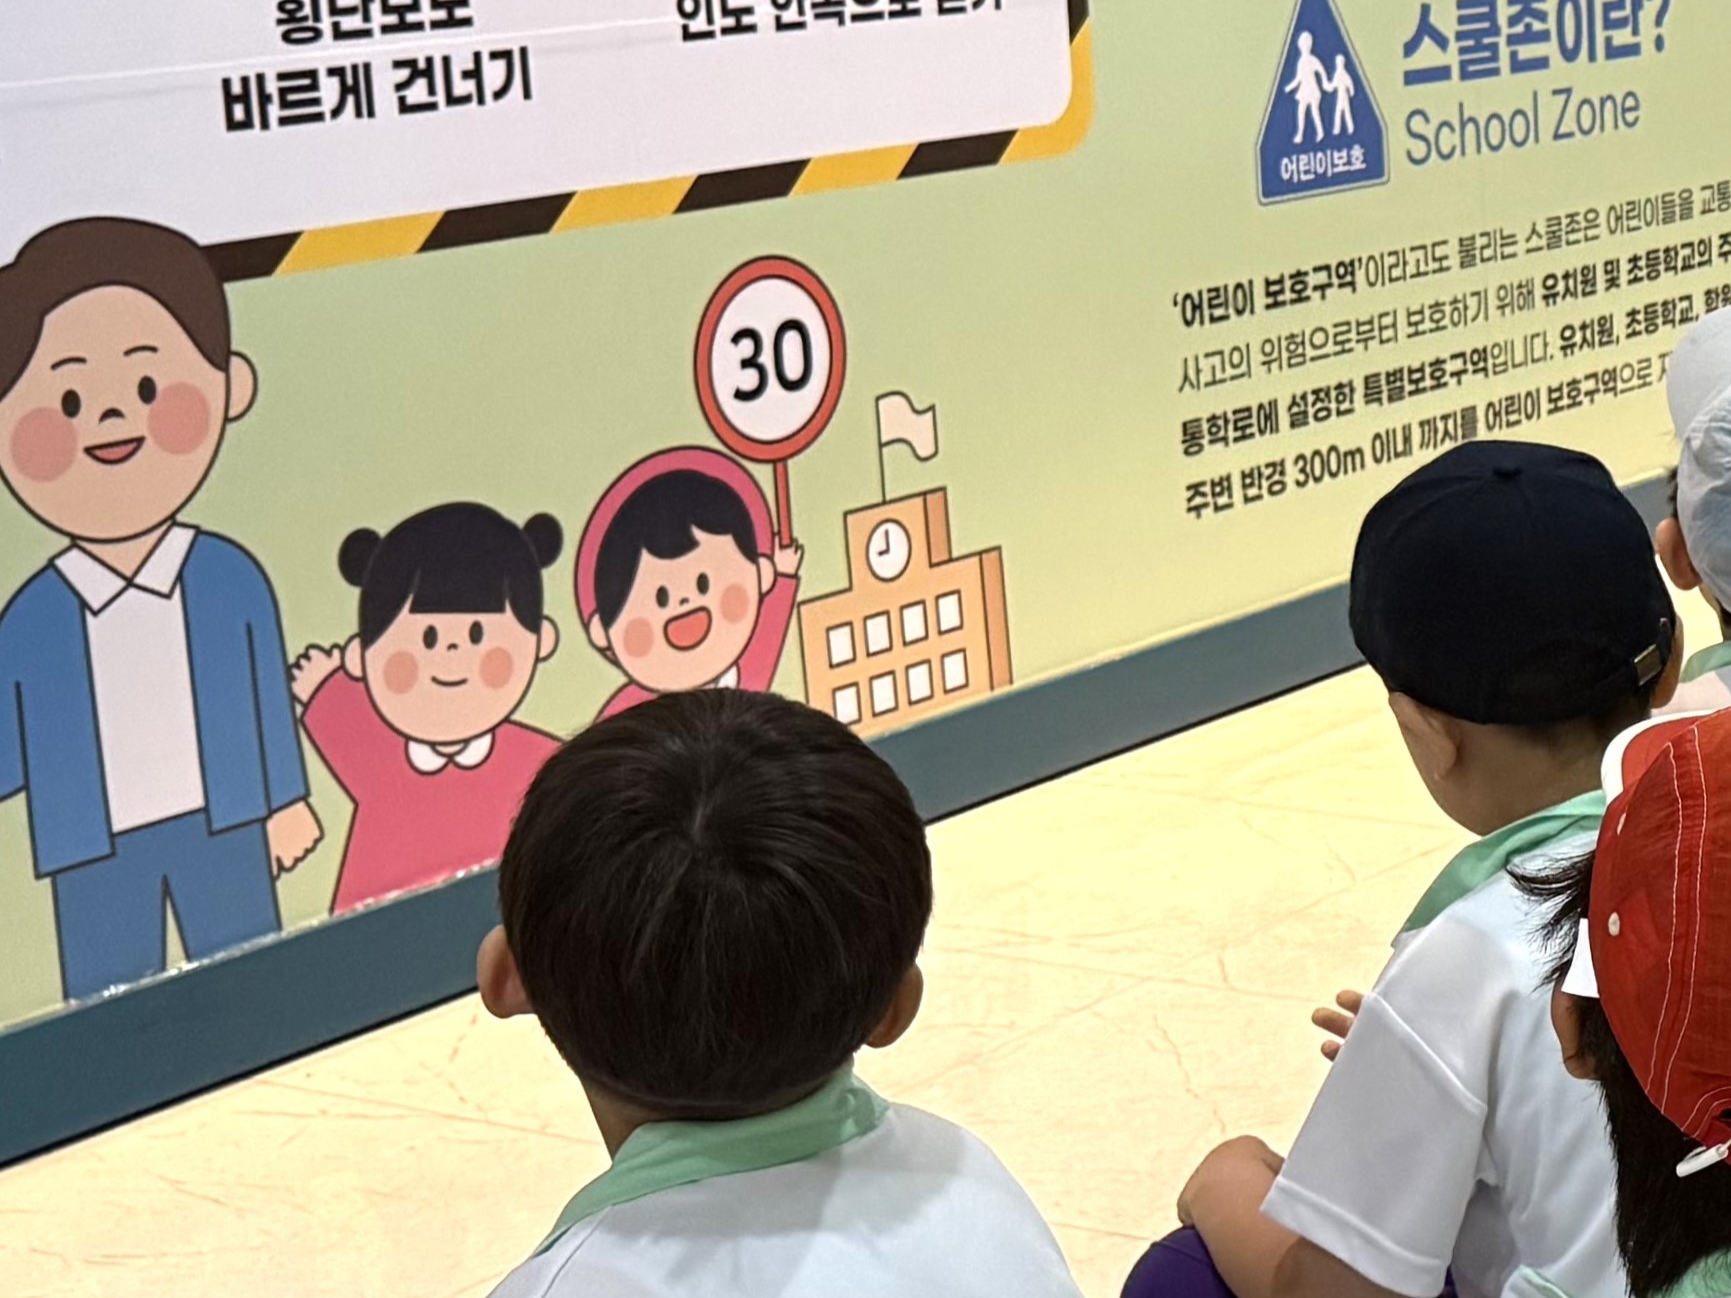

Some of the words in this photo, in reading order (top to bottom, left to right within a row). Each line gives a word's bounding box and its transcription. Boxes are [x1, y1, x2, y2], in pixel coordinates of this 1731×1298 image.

[221, 62, 374, 134] 바르게
[393, 46, 534, 113] 건너기
[1405, 90, 1540, 167] School
[1551, 86, 1641, 142] Zone
[1281, 143, 1367, 183] 어린이보호
[1457, 227, 1518, 270] 불리는
[1525, 207, 1600, 255] 스쿨존은
[1606, 188, 1694, 235] 어린이들을
[1699, 179, 1731, 215] 교통
[1178, 342, 1252, 393] 사고의
[1259, 309, 1399, 375] 위험으로부터
[1405, 287, 1490, 339] 보호하기
[1495, 277, 1536, 318] 위해
[1542, 262, 1598, 308] 유치원
[1603, 257, 1621, 292] 및
[1626, 236, 1713, 286] 초등학교의
[730, 318, 813, 403] 30
[1180, 398, 1280, 457] 통학로에
[1287, 379, 1356, 431] 설정한
[1363, 330, 1554, 408] 특별보호구역입니다.
[1559, 312, 1620, 358] 유치원,
[1625, 293, 1700, 340] 초등학교,
[1185, 473, 1234, 520] 주변
[1240, 457, 1287, 505] 반경
[1293, 444, 1366, 488] 300m
[1371, 421, 1413, 465] 이내
[1418, 403, 1479, 452] 까지를
[1484, 387, 1542, 432] 어린이
[1546, 357, 1654, 417] 보호구역으로
